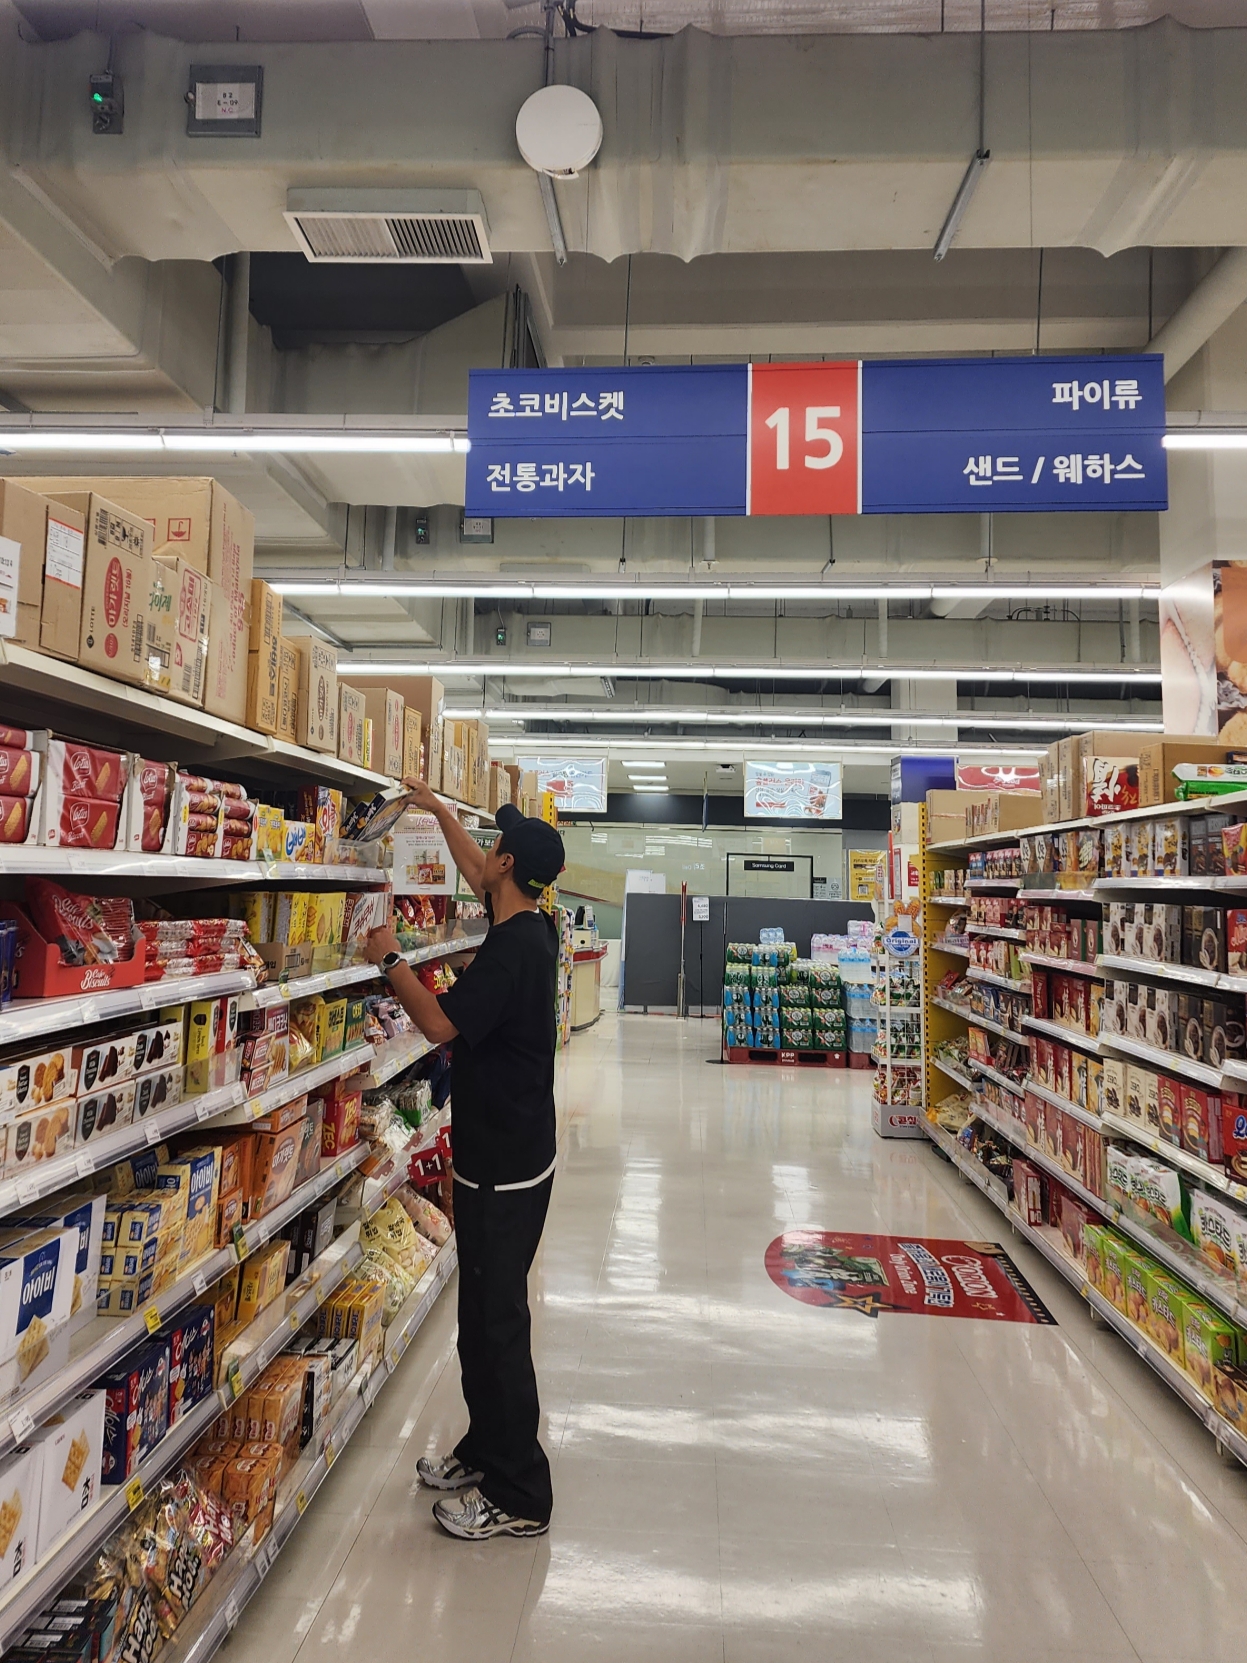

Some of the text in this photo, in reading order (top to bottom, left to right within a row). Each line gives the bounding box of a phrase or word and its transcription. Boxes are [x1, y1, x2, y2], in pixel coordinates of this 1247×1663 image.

[488, 391, 625, 421] 초코비스켓
[1052, 379, 1143, 411] 파이류
[765, 405, 845, 471] 15
[486, 461, 596, 494] 전통과자
[963, 454, 1023, 487] 샌드
[1053, 452, 1147, 486] 웨하스
[885, 936, 917, 945] Original
[322, 1122, 336, 1150] ZEC
[414, 1153, 442, 1177] 1+1
[22, 1265, 56, 1307] 아이비
[889, 1253, 917, 1294] Only Orion Zone
[950, 1263, 998, 1299] ORION
